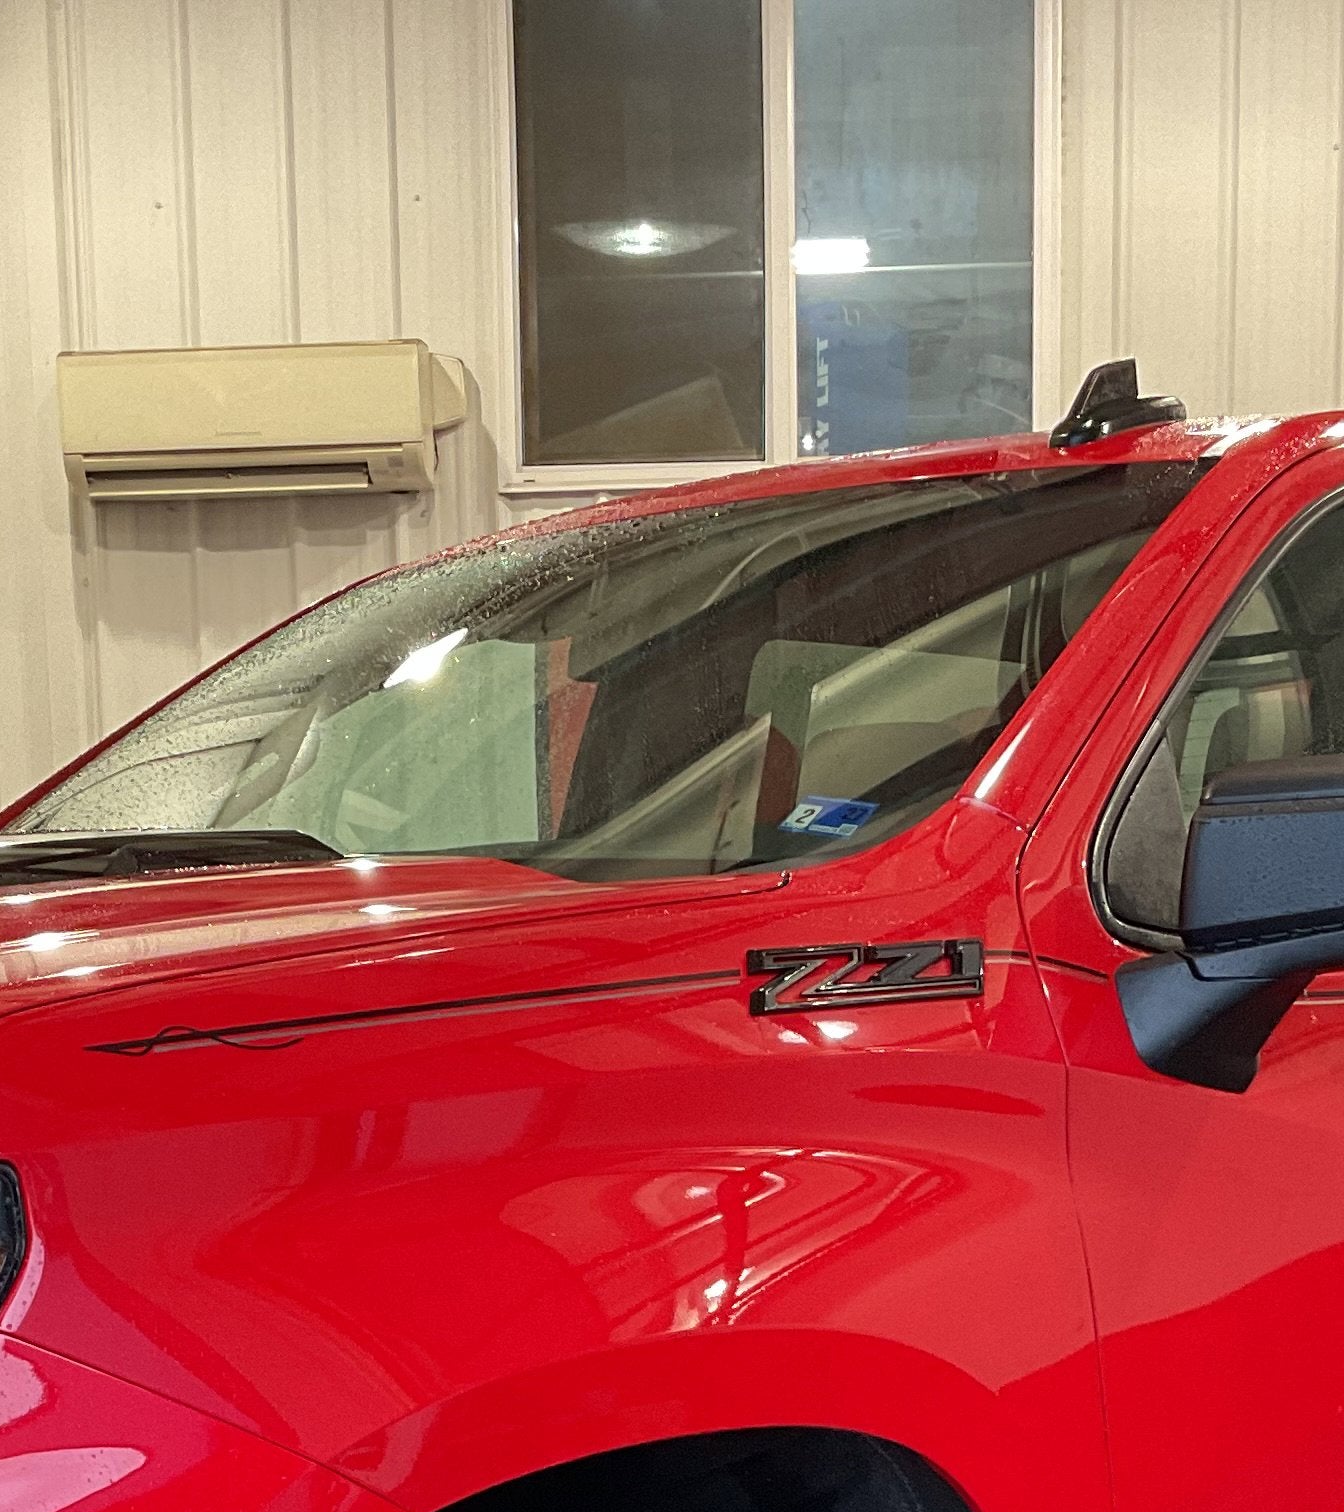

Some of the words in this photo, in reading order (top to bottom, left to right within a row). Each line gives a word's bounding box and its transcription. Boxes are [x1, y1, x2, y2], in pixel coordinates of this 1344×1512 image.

[816, 336, 829, 408] LIFT
[794, 807, 816, 824] 2
[746, 937, 984, 1017] Z71
